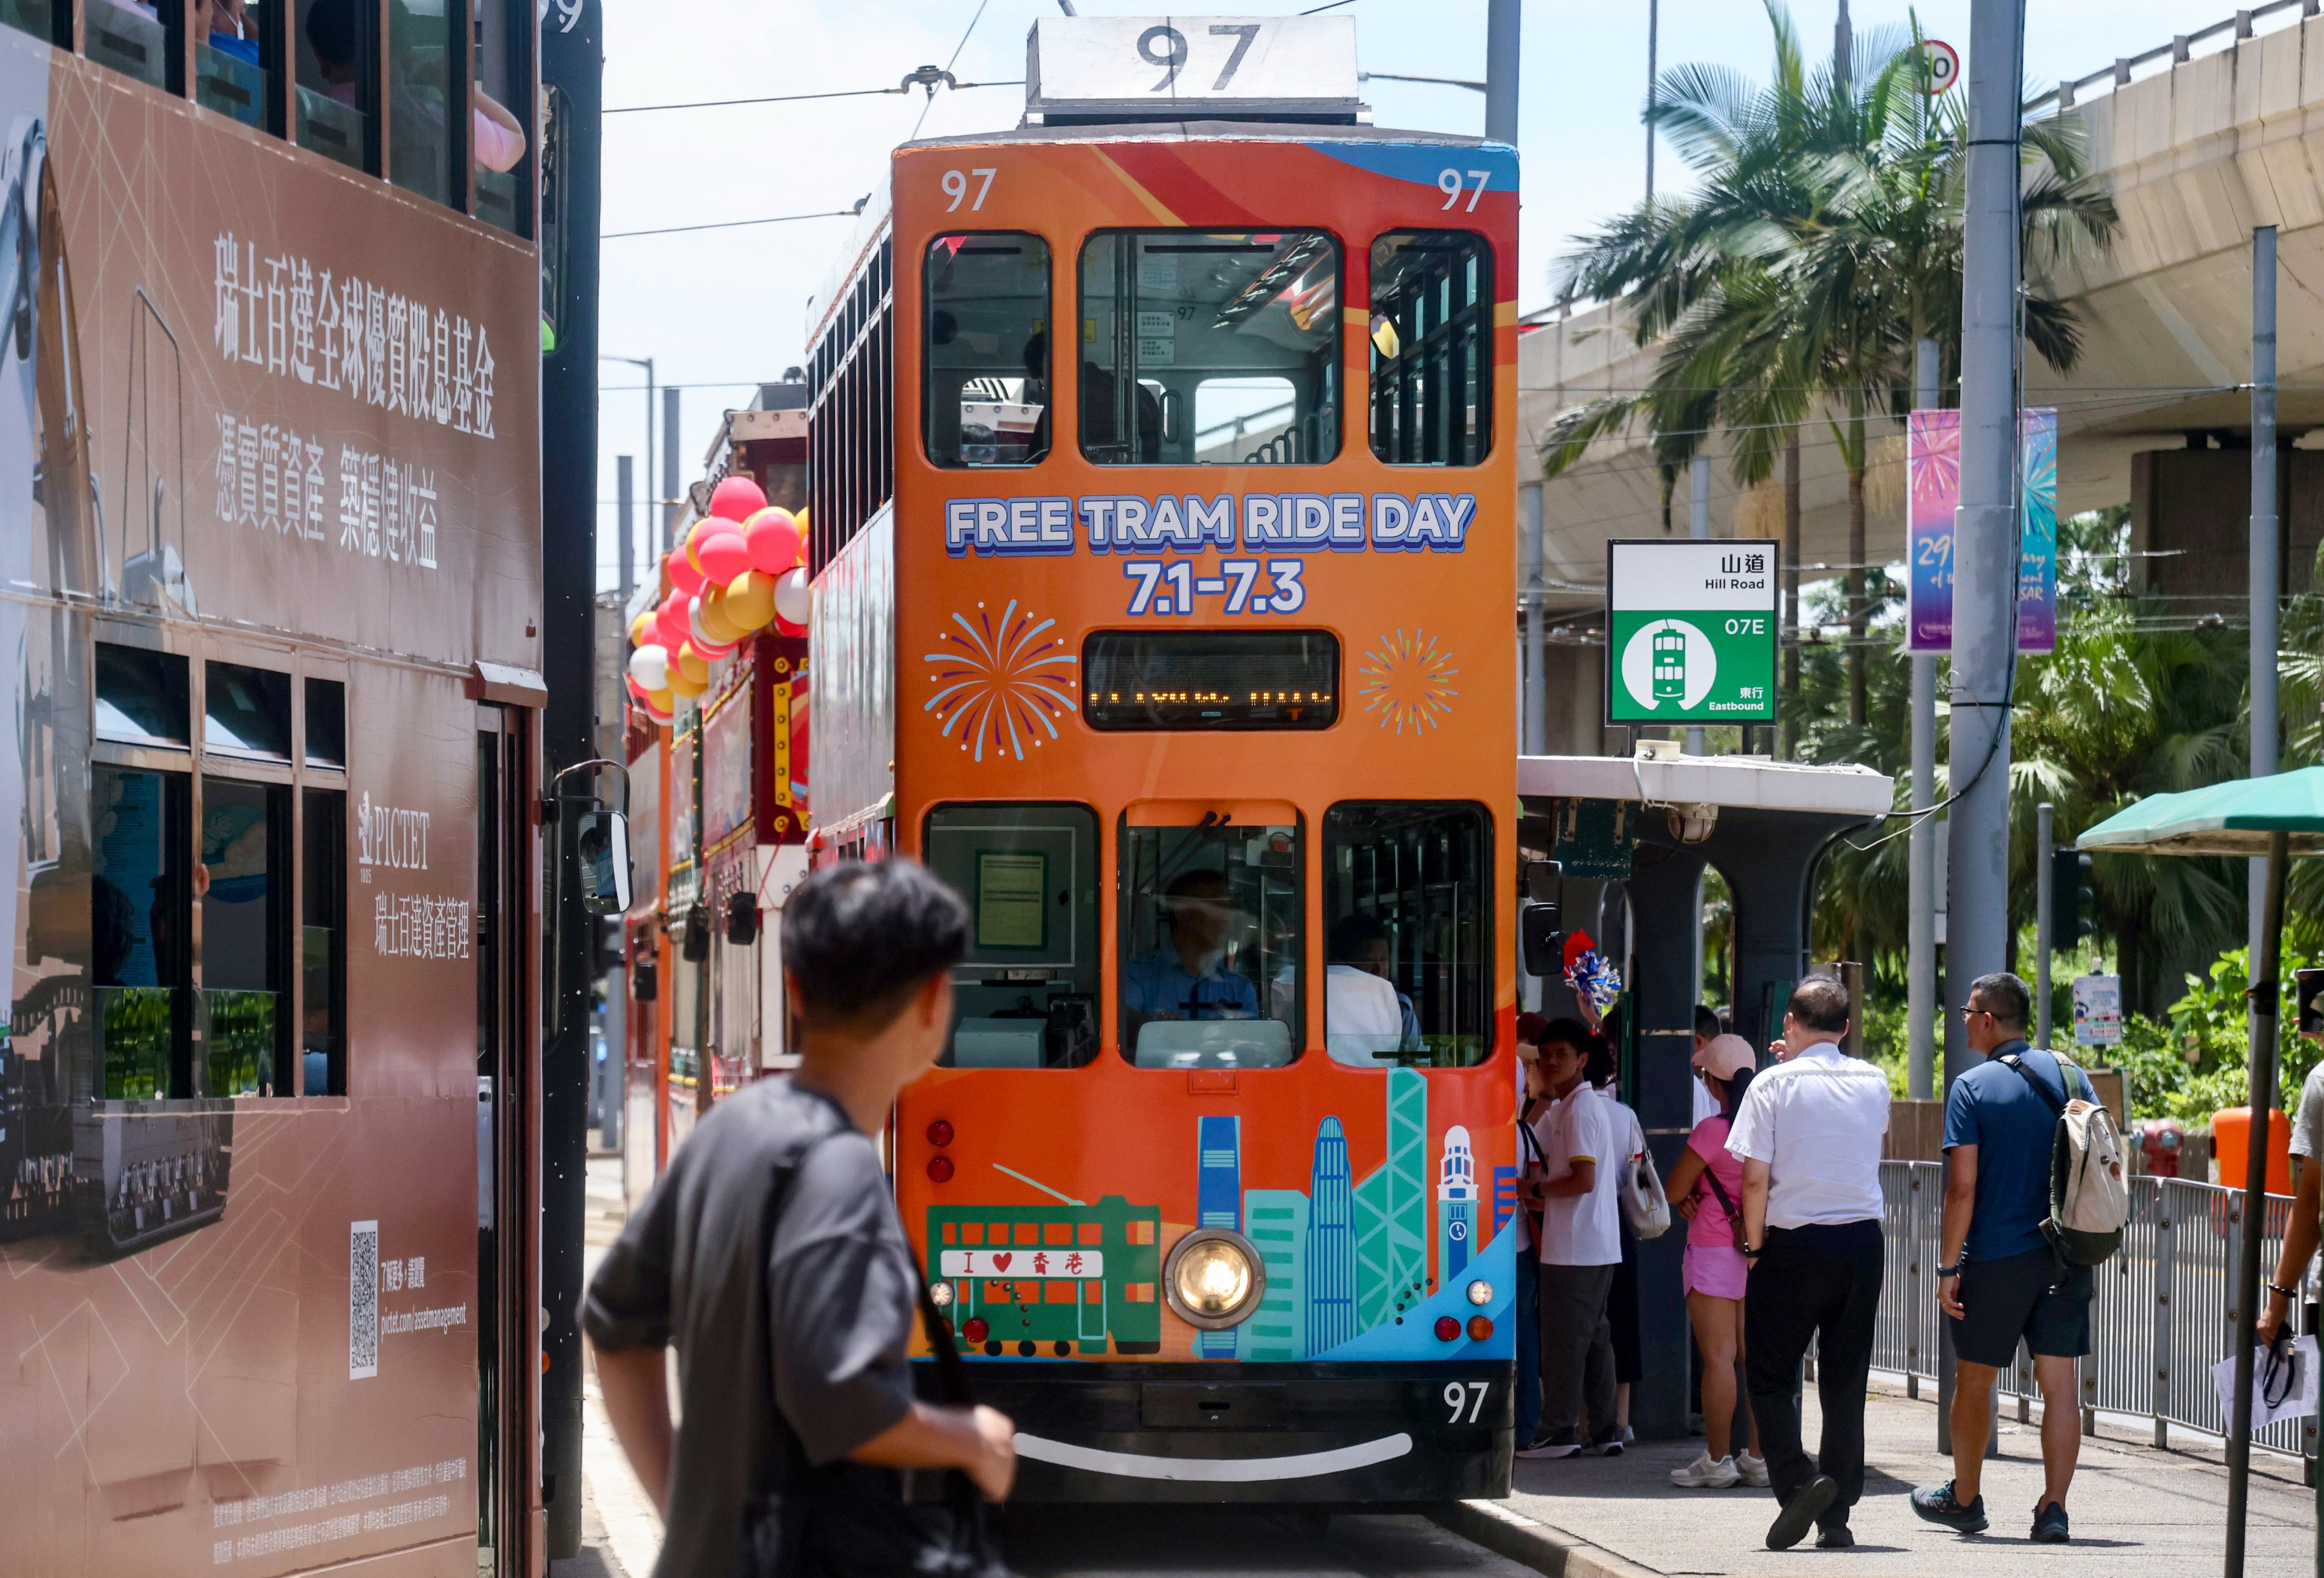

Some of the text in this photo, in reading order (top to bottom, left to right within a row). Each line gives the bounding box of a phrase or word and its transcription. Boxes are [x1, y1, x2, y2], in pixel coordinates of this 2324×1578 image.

[1137, 25, 1260, 92] 97
[942, 169, 997, 212] 97
[1438, 169, 1491, 212] 97
[1178, 306, 1196, 320] 97
[214, 232, 494, 439] 瑞士百達全球優質股息基金
[215, 412, 436, 569] 憑實質資產 築穩健收益
[946, 494, 1476, 553] FREE TRAM RIDE DAY
[1722, 554, 1764, 574] 山道
[1918, 535, 1953, 567] 29
[1705, 579, 1764, 589] Hill Road
[1709, 702, 1763, 710] Eastbound
[1740, 687, 1763, 698] 東行
[375, 806, 430, 870] PICTET
[360, 868, 371, 884] 1805
[375, 891, 469, 960] 瑞士百達資產管理
[964, 1252, 1083, 1275] I 香港
[381, 1302, 467, 1344] pictet.com/assetmanagement
[1444, 1382, 1489, 1424] 97
